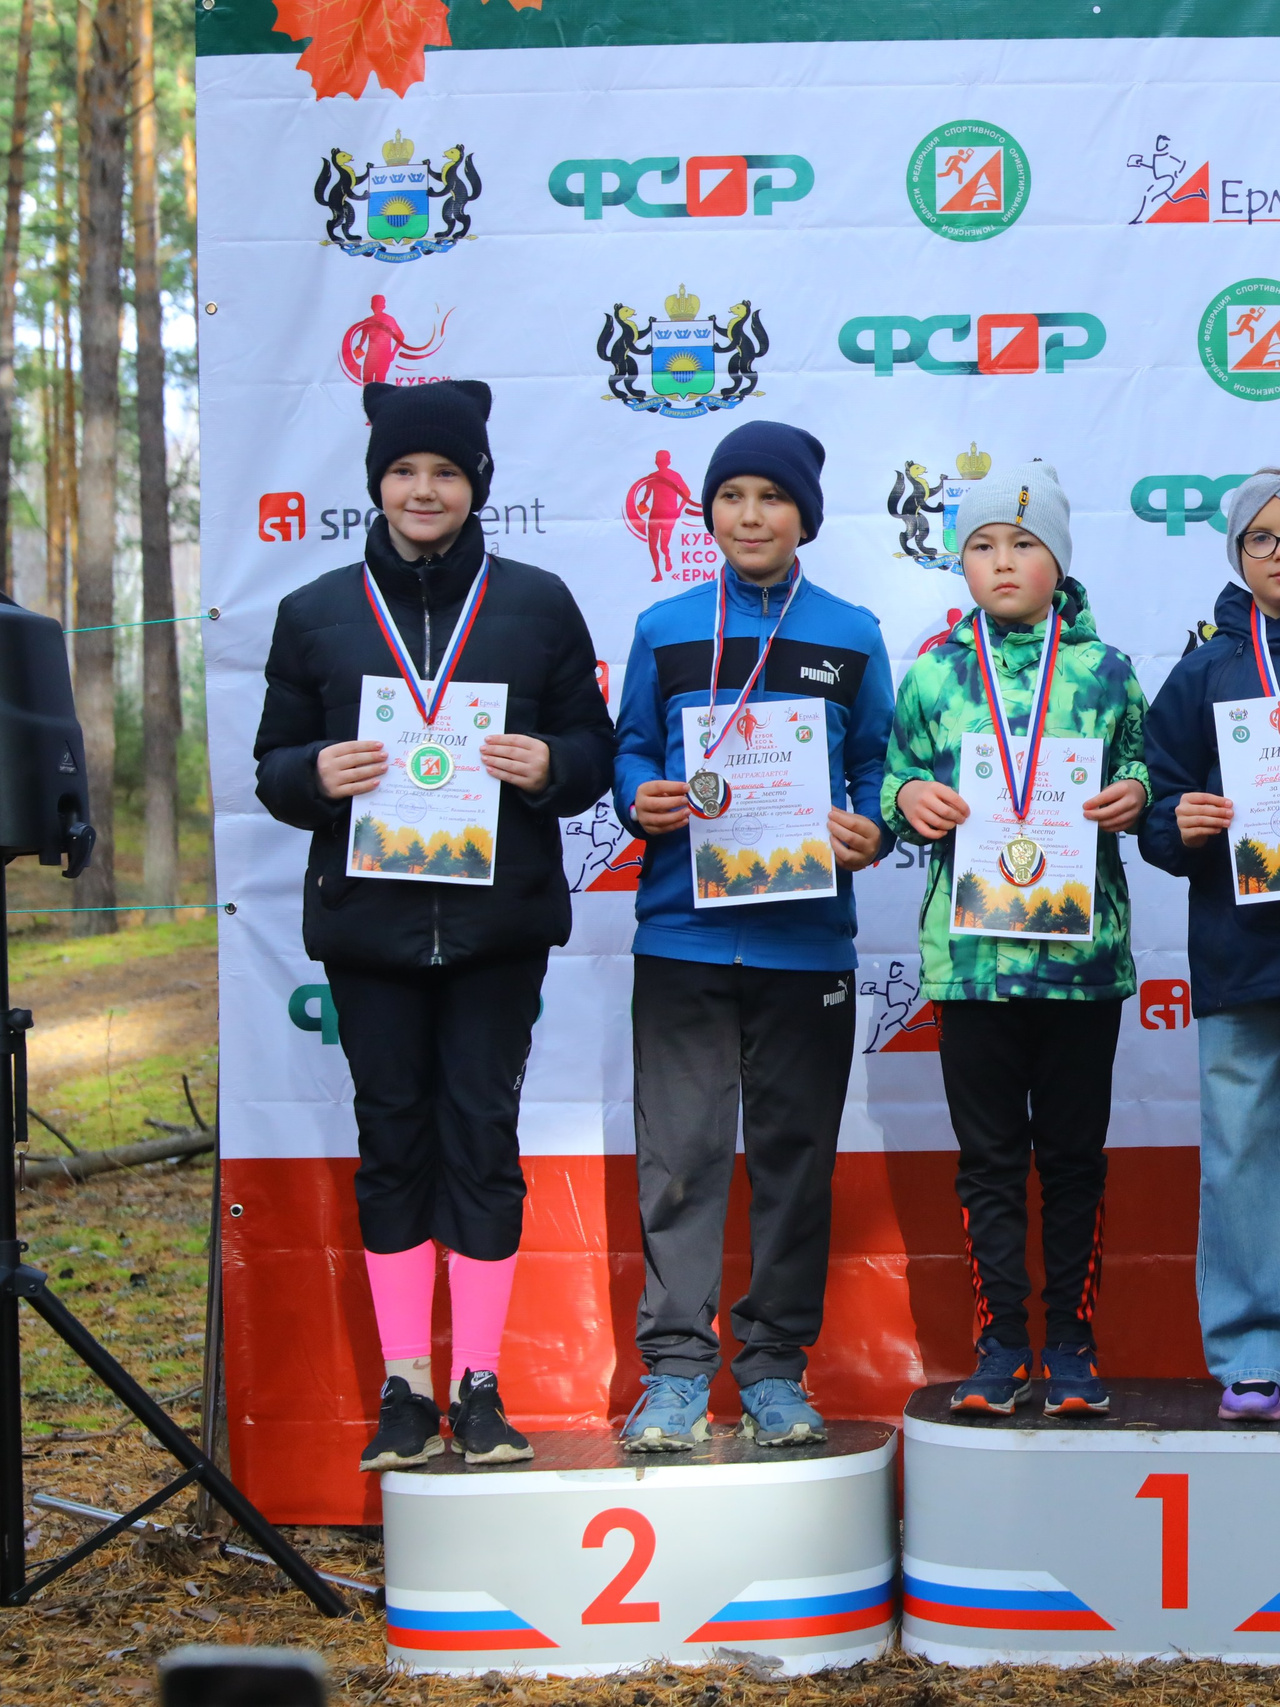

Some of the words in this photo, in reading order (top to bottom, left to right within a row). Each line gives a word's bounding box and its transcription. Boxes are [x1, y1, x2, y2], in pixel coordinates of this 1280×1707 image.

[944, 125, 1006, 144] СПОРТИВНОГО
[912, 136, 940, 182] ФЕДЕРАЦИЯ
[1001, 148, 1025, 223] ОРИЕНТИРОВАНИЯ
[912, 187, 937, 223] ОБЛАСТИ
[941, 224, 997, 236] ТЮМЕНСКОЙ
[1204, 295, 1231, 342] ФЕДЕРАЦИЯ
[1204, 346, 1229, 382] ОБЛАСТИ
[681, 533, 717, 546] КУБ
[681, 551, 717, 563] КСО
[671, 569, 716, 581] «ЕРМ
[800, 666, 835, 685] PUMA
[398, 731, 468, 747] ДИПЛОМ
[724, 751, 792, 768] ДИПЛОМ
[731, 770, 788, 779] НАГРАЖДАЕТСЯ
[997, 788, 1065, 802] ДЛОМ
[823, 990, 846, 1007] PUMA
[1135, 1473, 1189, 1609] 1
[581, 1507, 661, 1625] 2
